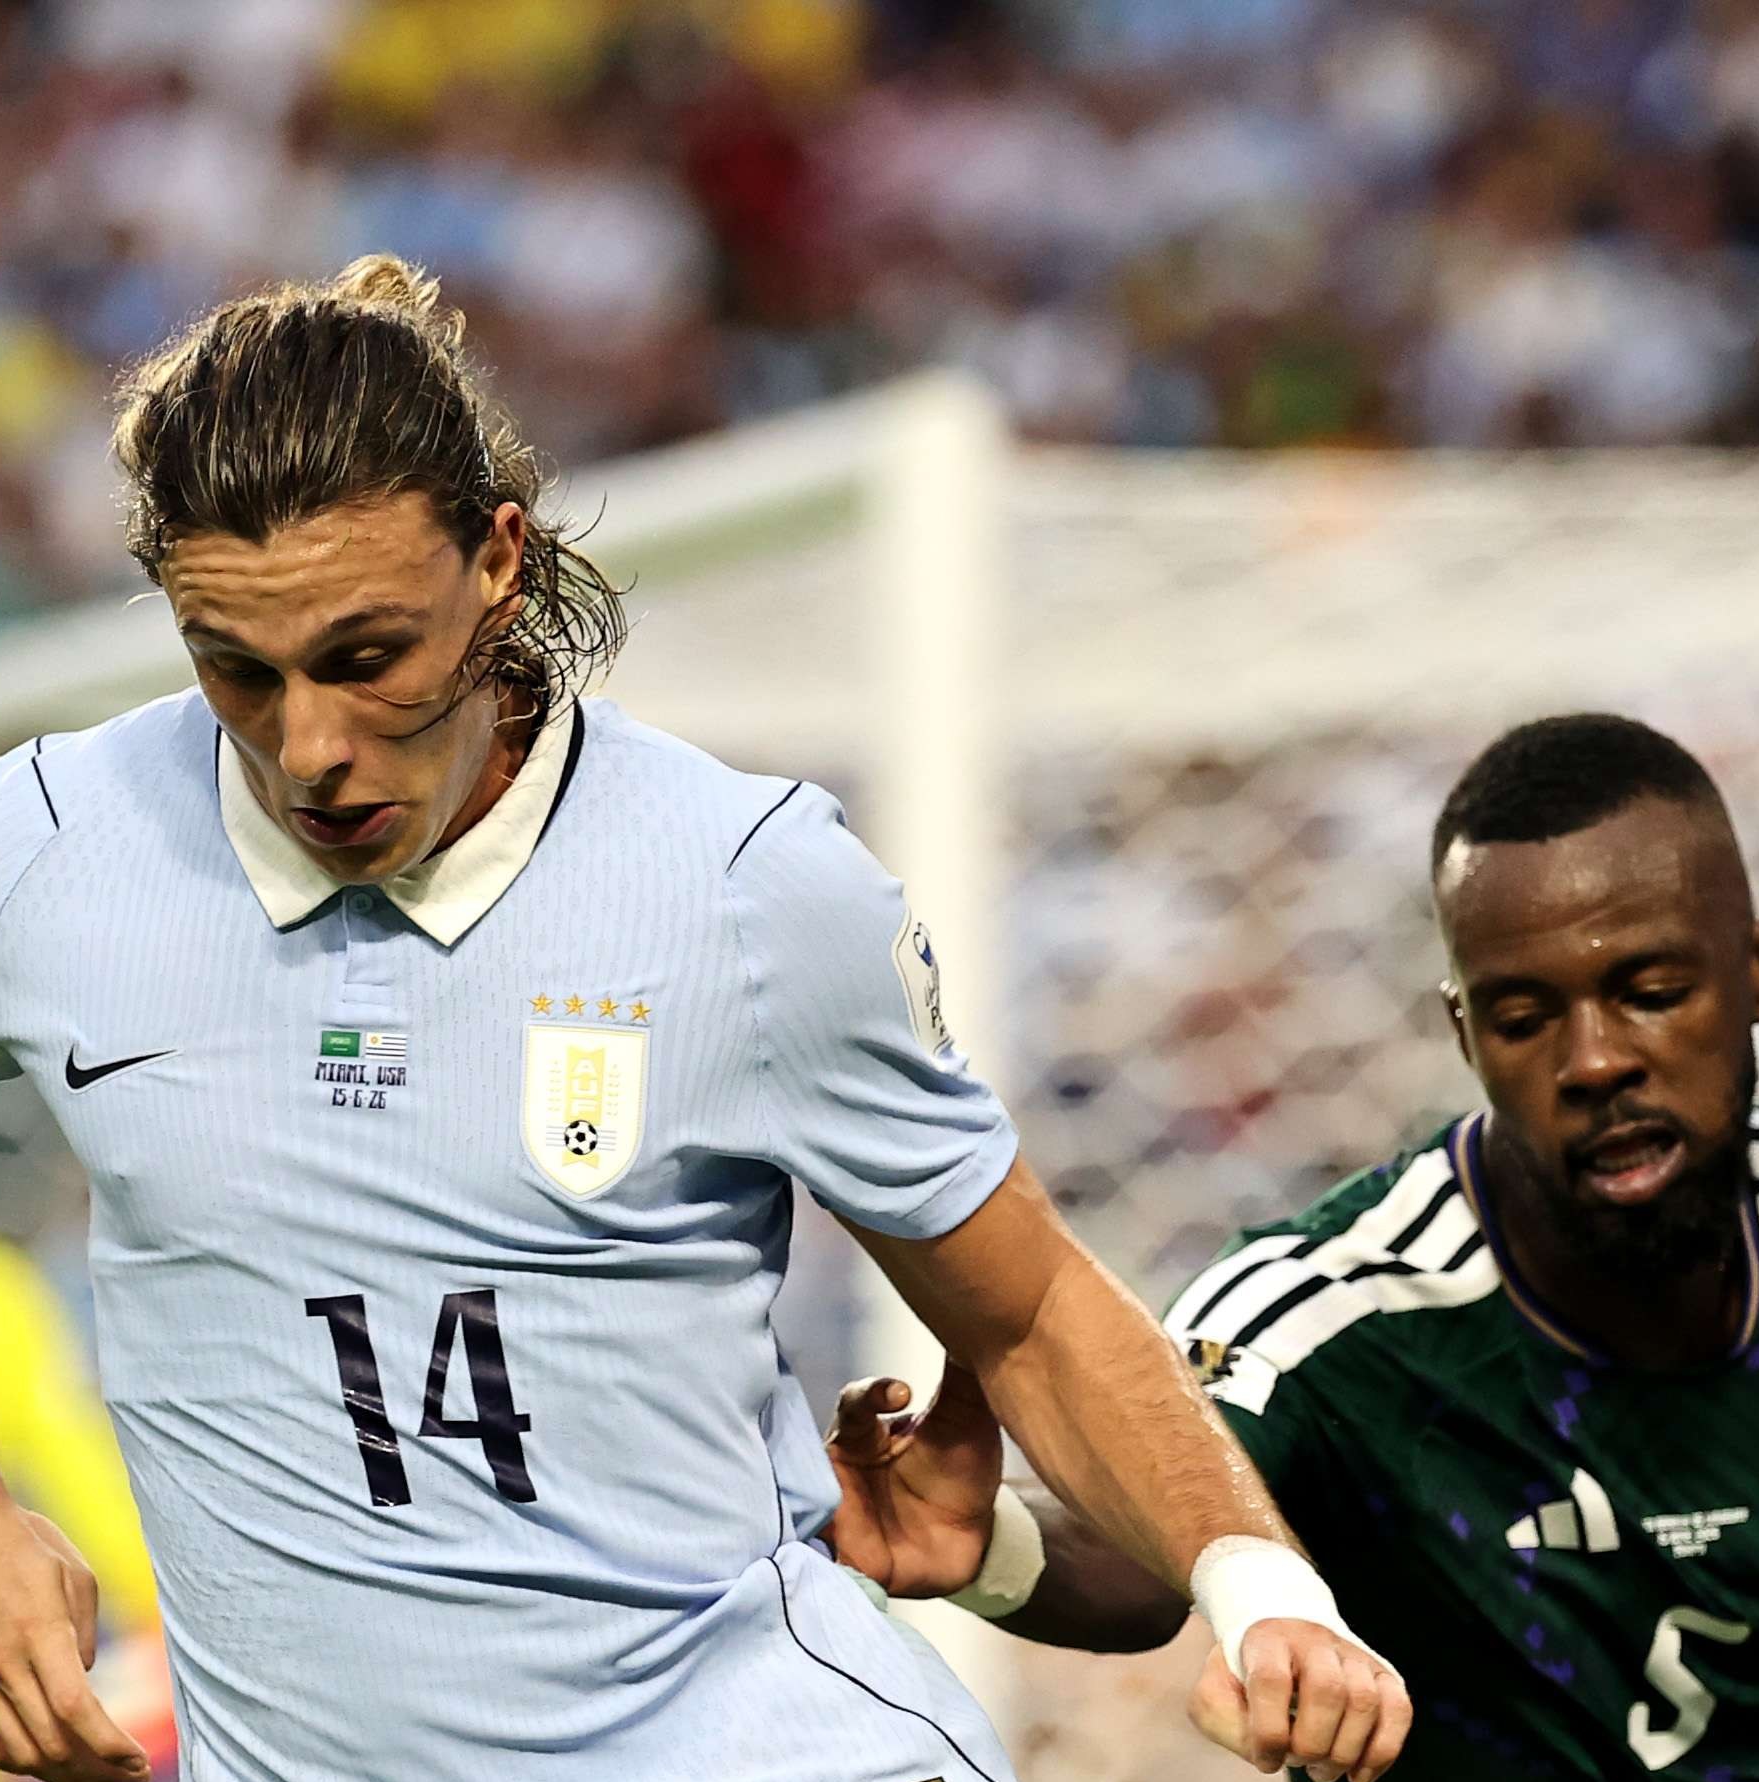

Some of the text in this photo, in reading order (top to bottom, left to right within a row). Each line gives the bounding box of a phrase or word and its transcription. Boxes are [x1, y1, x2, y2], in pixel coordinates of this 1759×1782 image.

[315, 1062, 407, 1086] MIAMI, USA
[304, 1289, 538, 1507] 14
[1627, 1605, 1751, 1771] 5
